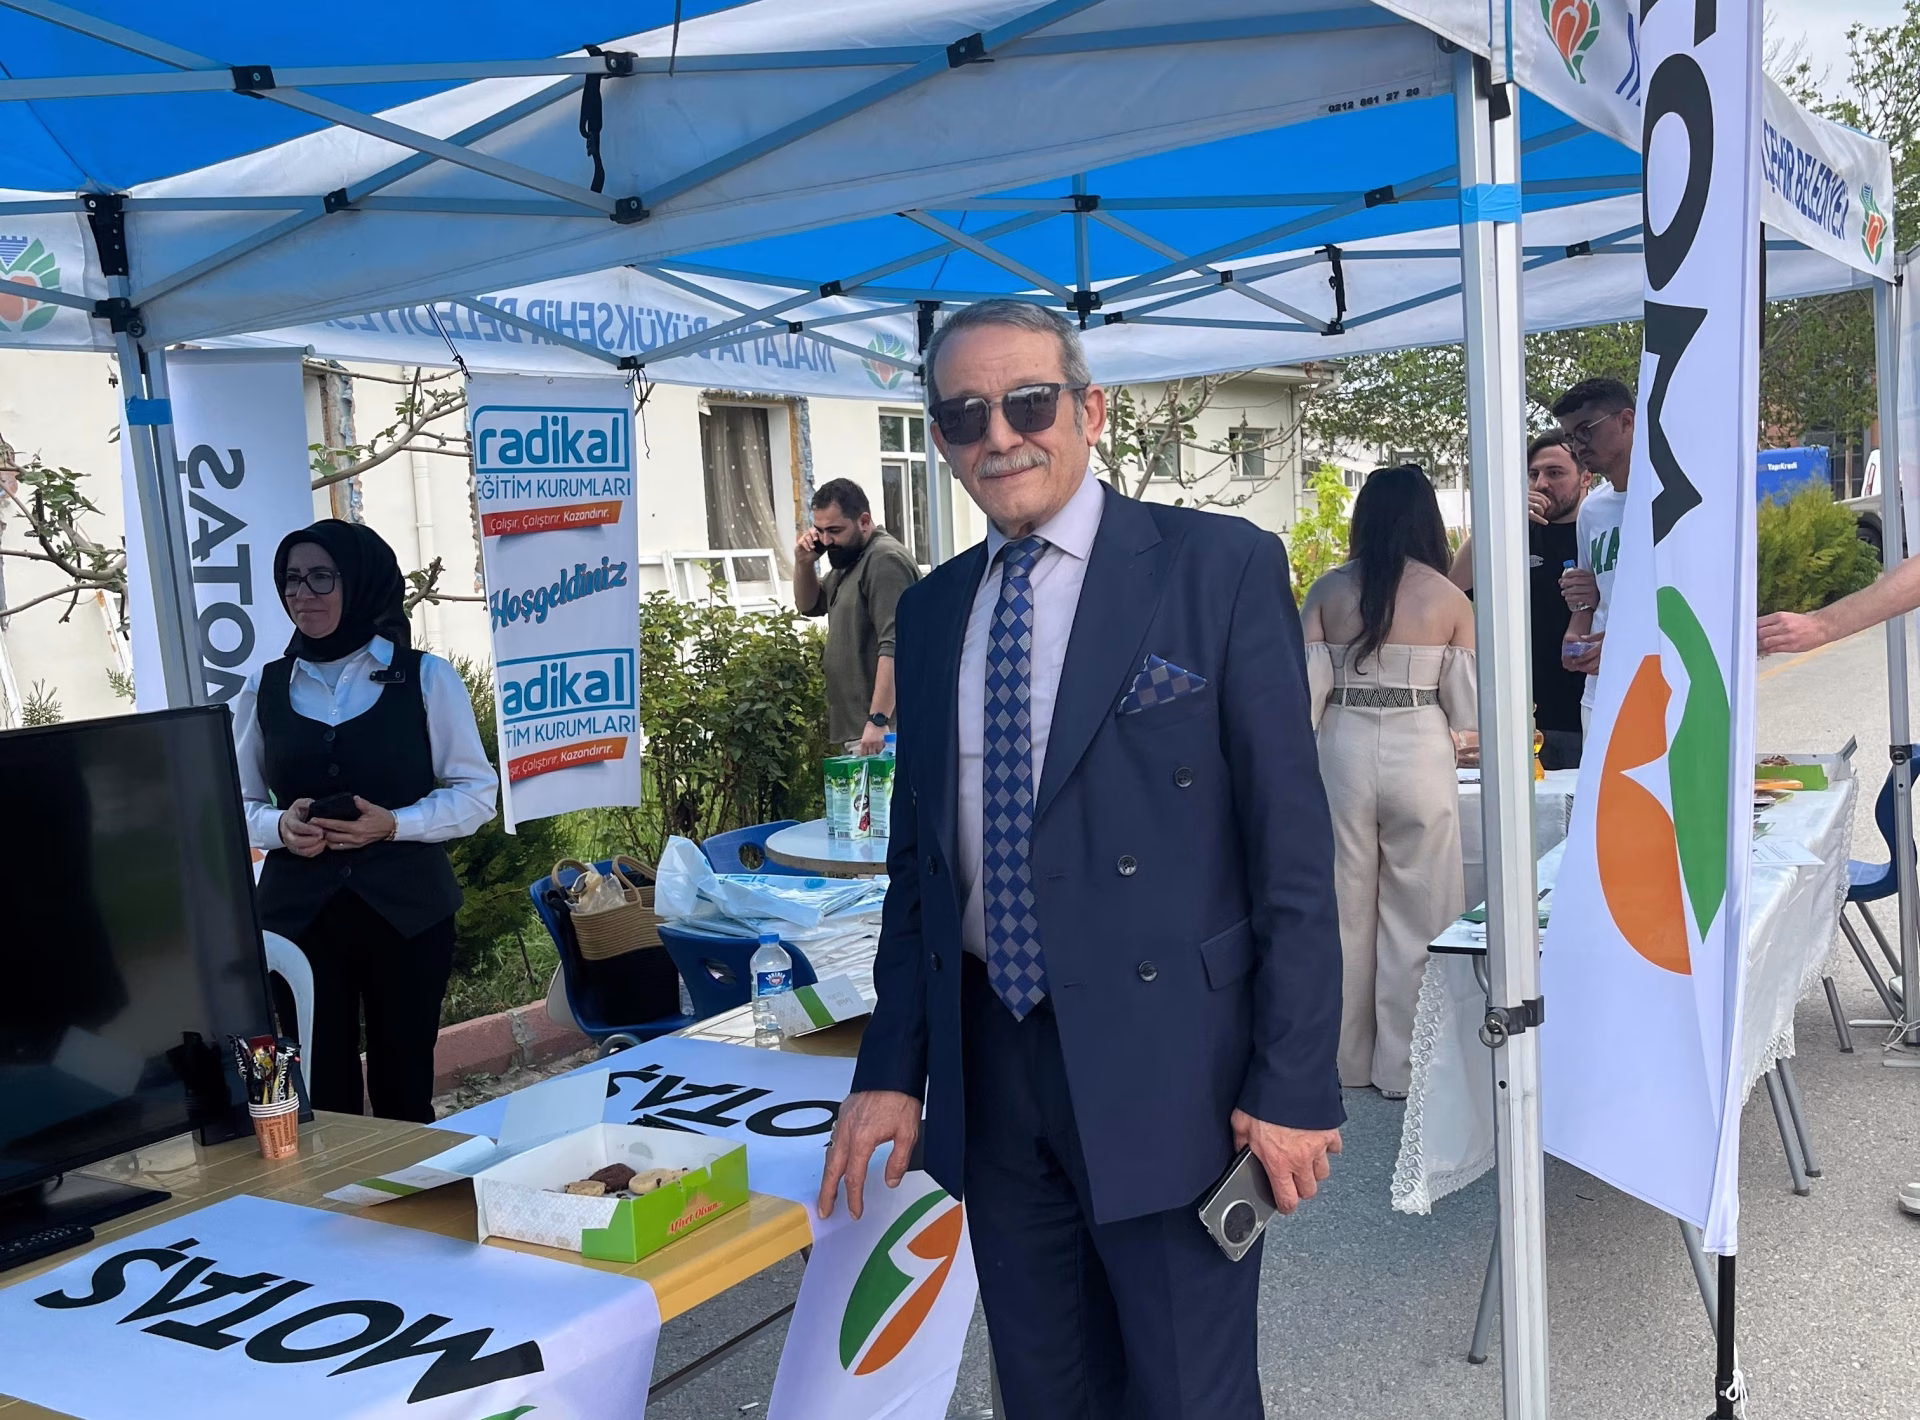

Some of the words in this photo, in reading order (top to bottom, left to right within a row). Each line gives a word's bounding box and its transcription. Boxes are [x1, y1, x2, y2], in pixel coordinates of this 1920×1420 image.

[1328, 100, 1354, 113] 0212
[1385, 91, 1400, 102] 27
[1405, 87, 1420, 98] 20
[1760, 117, 1796, 206] ŞEHİR
[479, 415, 620, 465] radikal
[537, 477, 631, 498] KURUMLARI
[563, 508, 610, 523] Kazandırır.
[1590, 526, 1621, 576] MA
[489, 556, 628, 633] Hoşgeldiniz
[502, 656, 625, 716] adikal
[505, 724, 531, 749] TİM
[535, 715, 636, 743] KURUMLARI
[606, 1063, 842, 1138] OTAŞ
[34, 1238, 545, 1404] MOTAŞ
